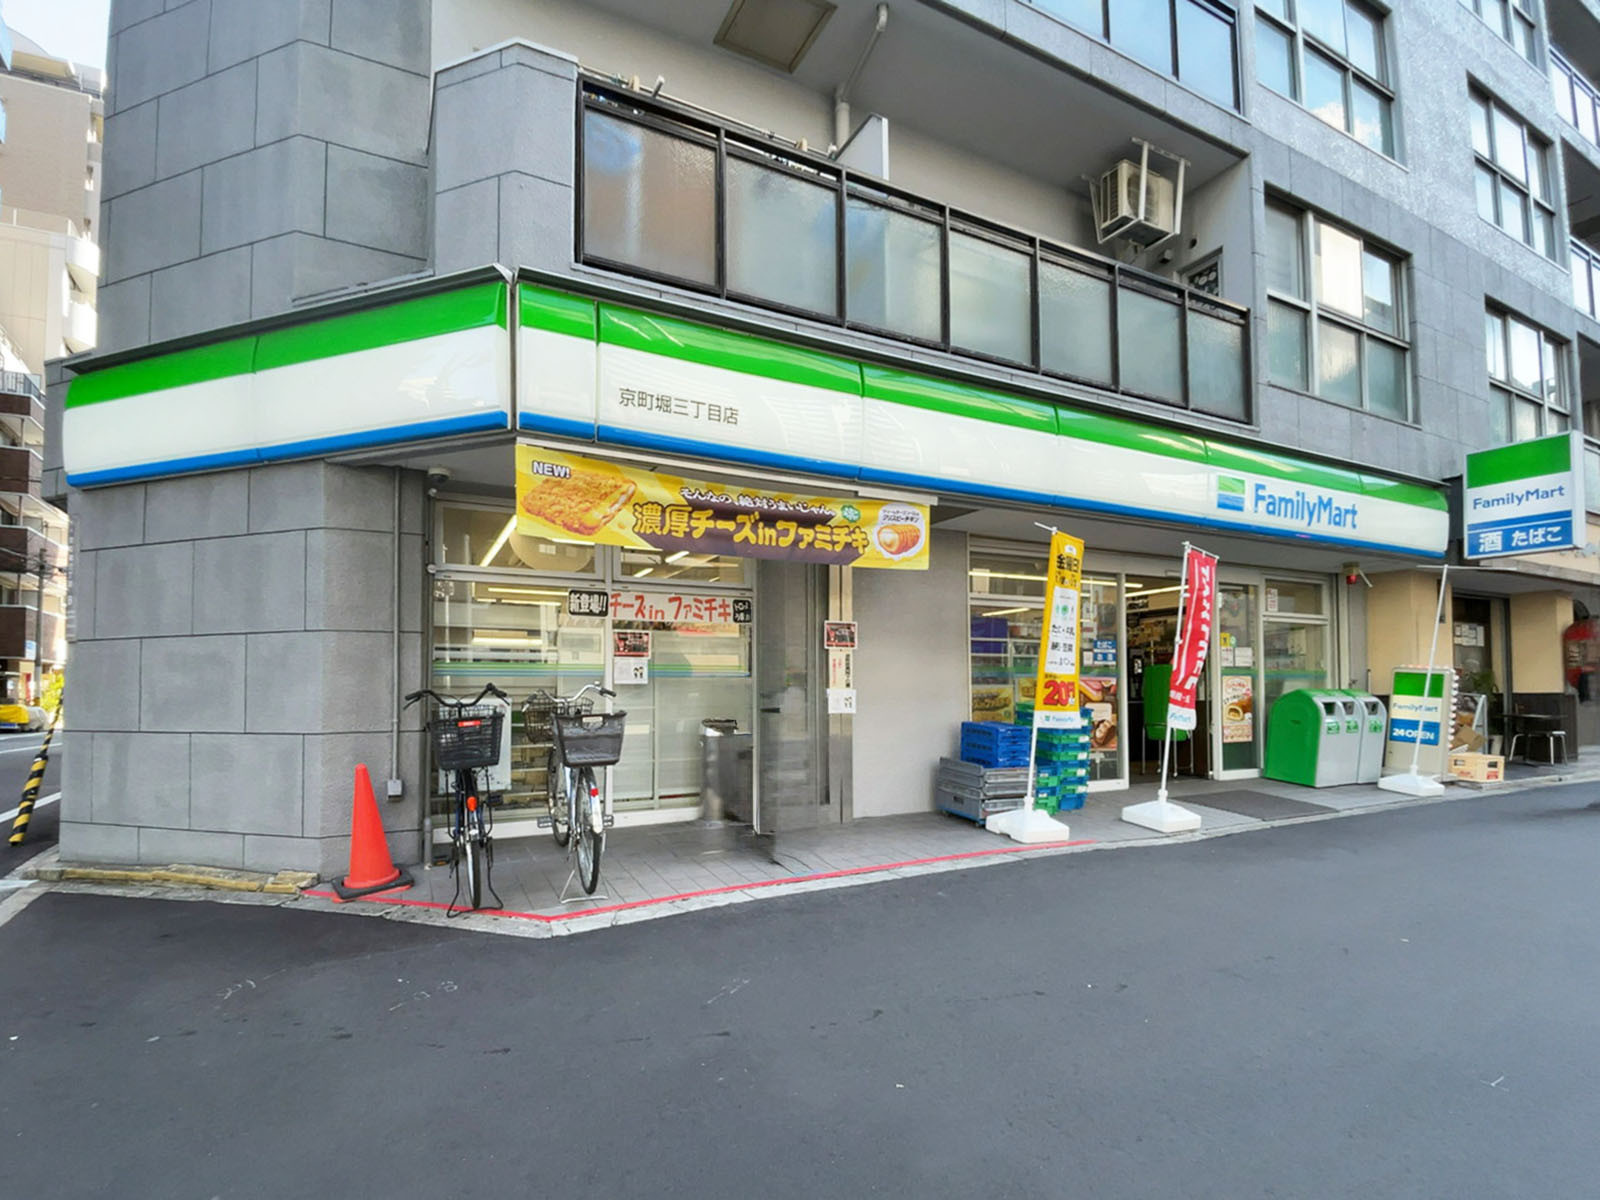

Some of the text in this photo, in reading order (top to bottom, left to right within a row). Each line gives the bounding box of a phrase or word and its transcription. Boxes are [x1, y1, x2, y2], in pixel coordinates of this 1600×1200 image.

[619, 387, 739, 425] 京町堀三丁目店
[532, 461, 571, 478] NEW!
[1254, 483, 1358, 529] FamilyMart
[1473, 485, 1565, 510] FamilyMart
[633, 502, 870, 555] 濃厚チーズinファミチキ
[1478, 526, 1563, 552] 酒 たばこ
